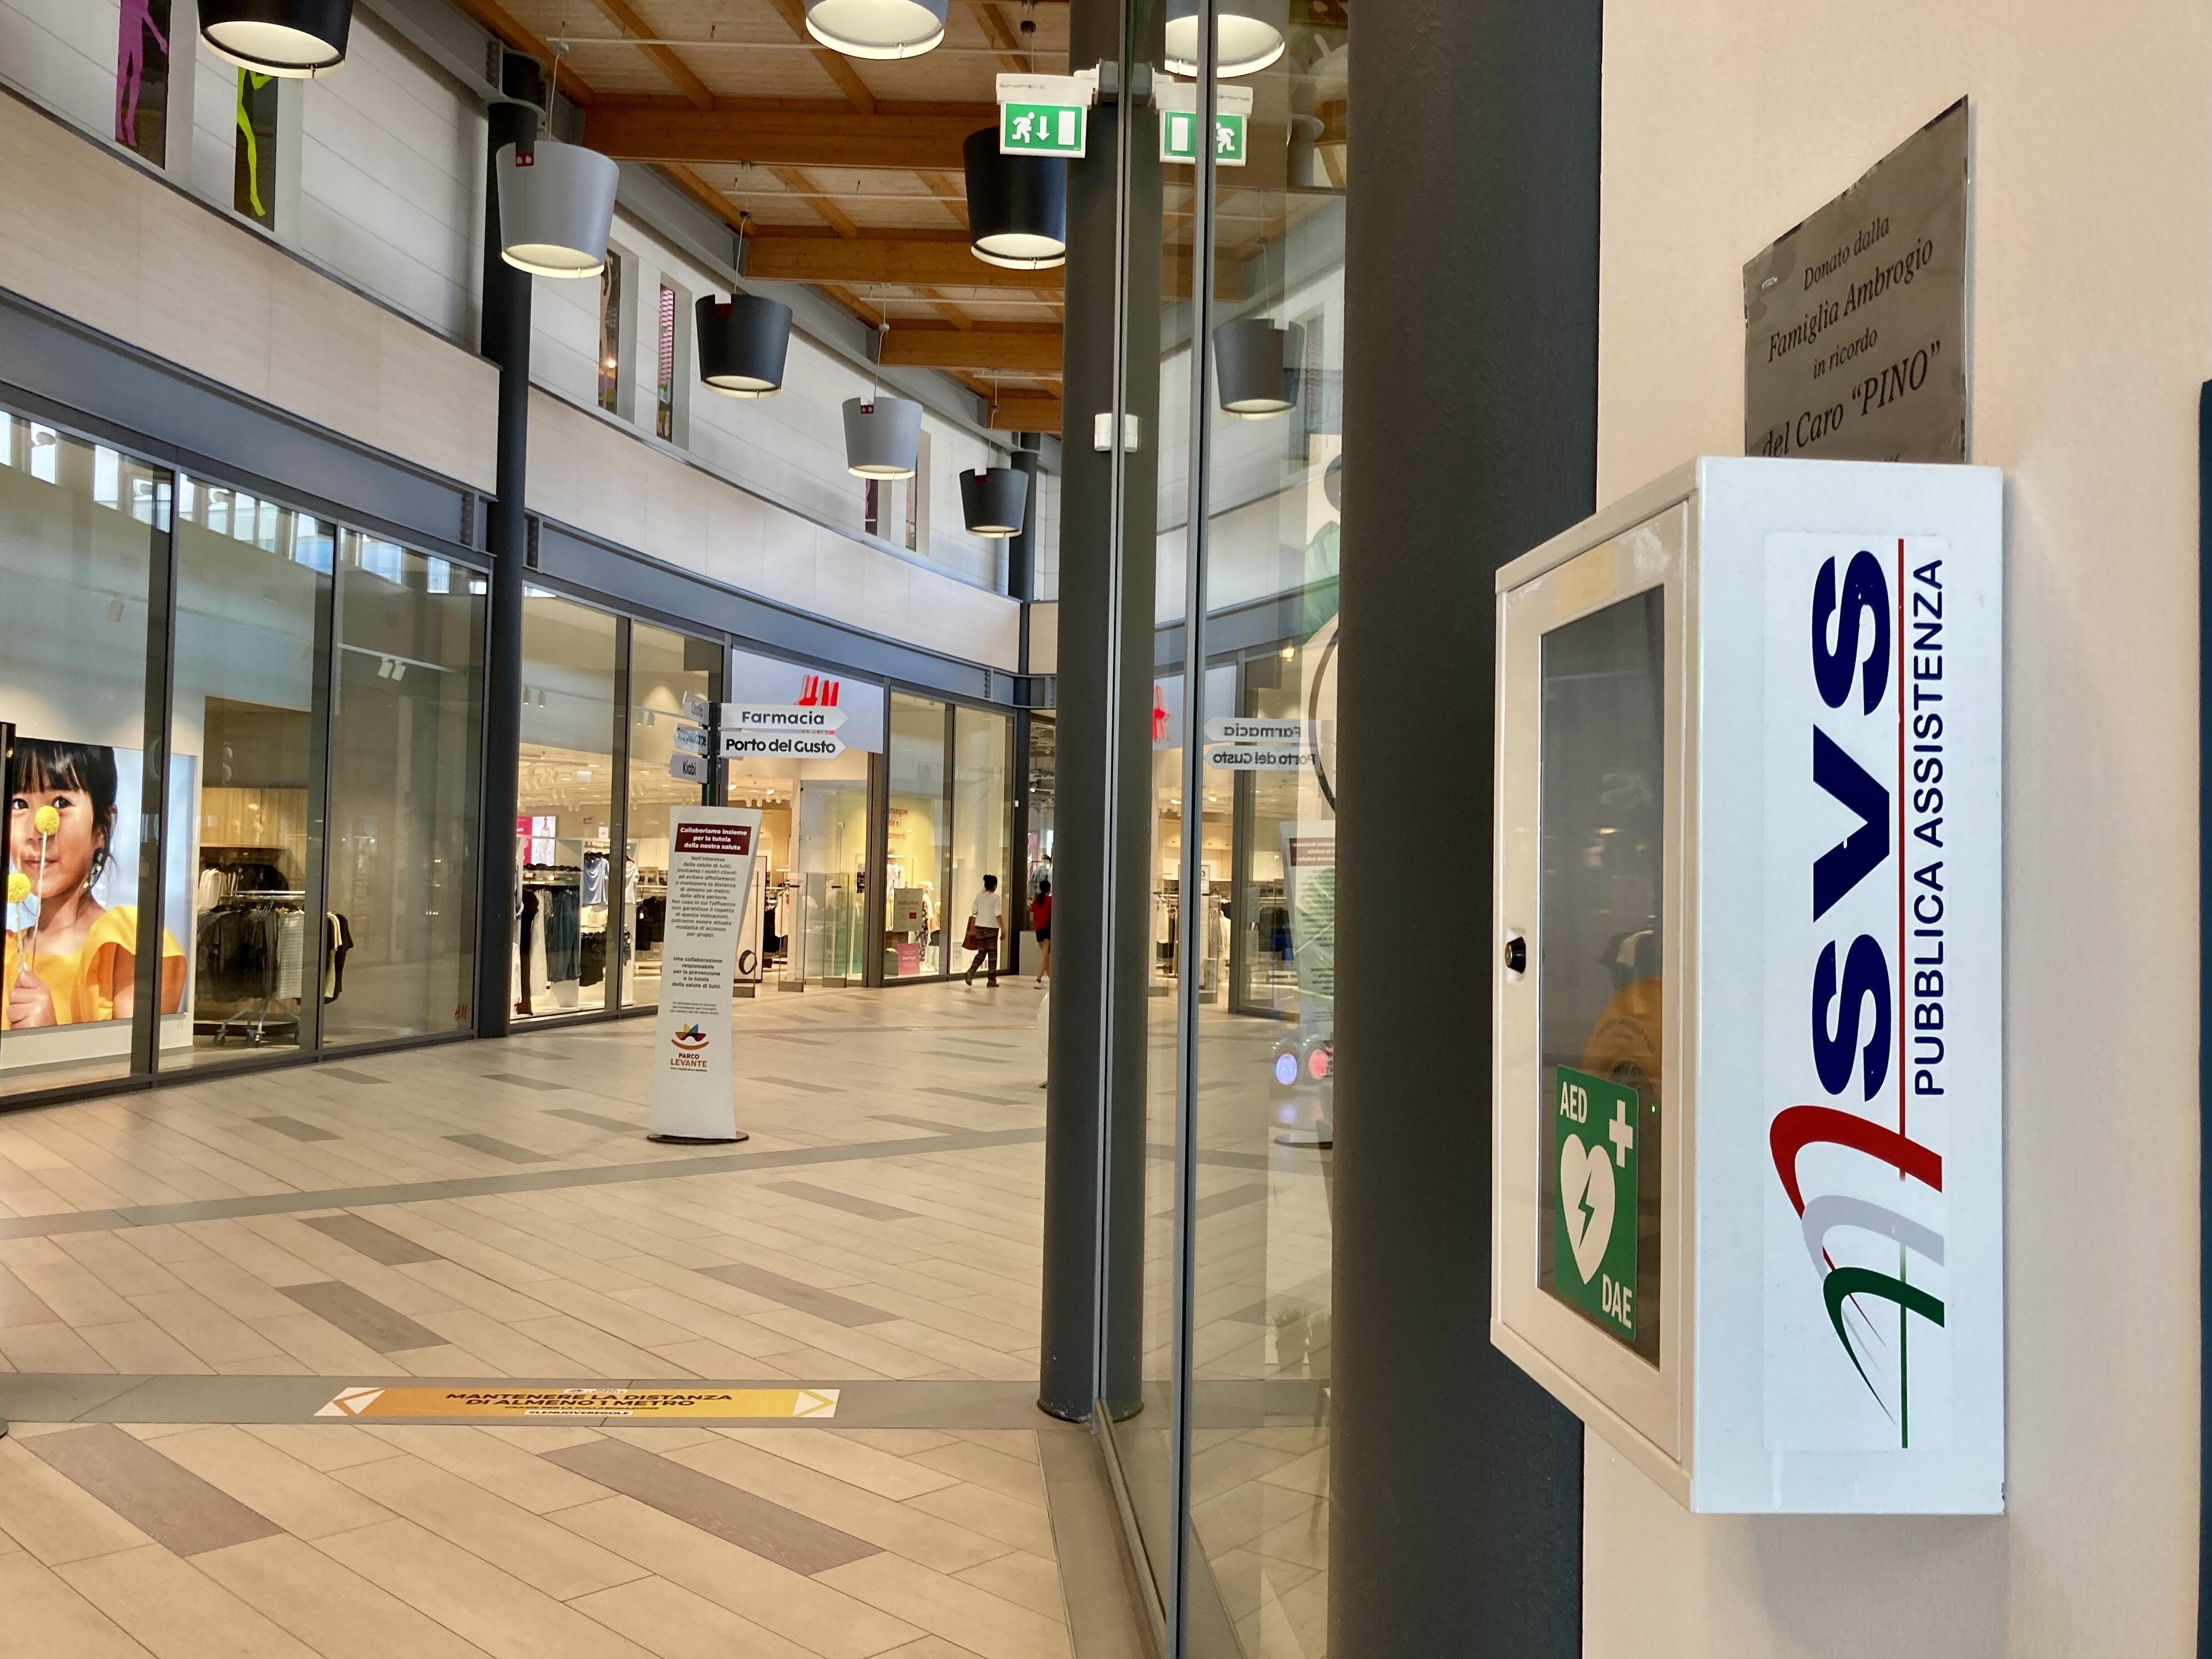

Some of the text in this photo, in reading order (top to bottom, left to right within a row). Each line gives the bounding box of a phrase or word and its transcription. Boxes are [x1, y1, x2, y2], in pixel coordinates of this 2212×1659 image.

[1804, 217, 1889, 290] Donato dalla
[1768, 239, 1933, 363] Famiglia Ambrogio
[1813, 327, 1878, 379] in ricordo
[1763, 421, 1790, 457] del
[1796, 403, 1844, 448] Caro
[742, 711, 824, 725] Farmacia
[683, 760, 696, 776] Kiabi
[726, 738, 836, 753] Porto del Gusto
[1812, 550, 1892, 1102] SVS
[1913, 559, 1945, 1096] PUBBLICA ASSISTENZA
[671, 1058, 707, 1067] LEVANTE
[1560, 1081, 1587, 1124] AED
[1602, 1273, 1632, 1329] DAE
